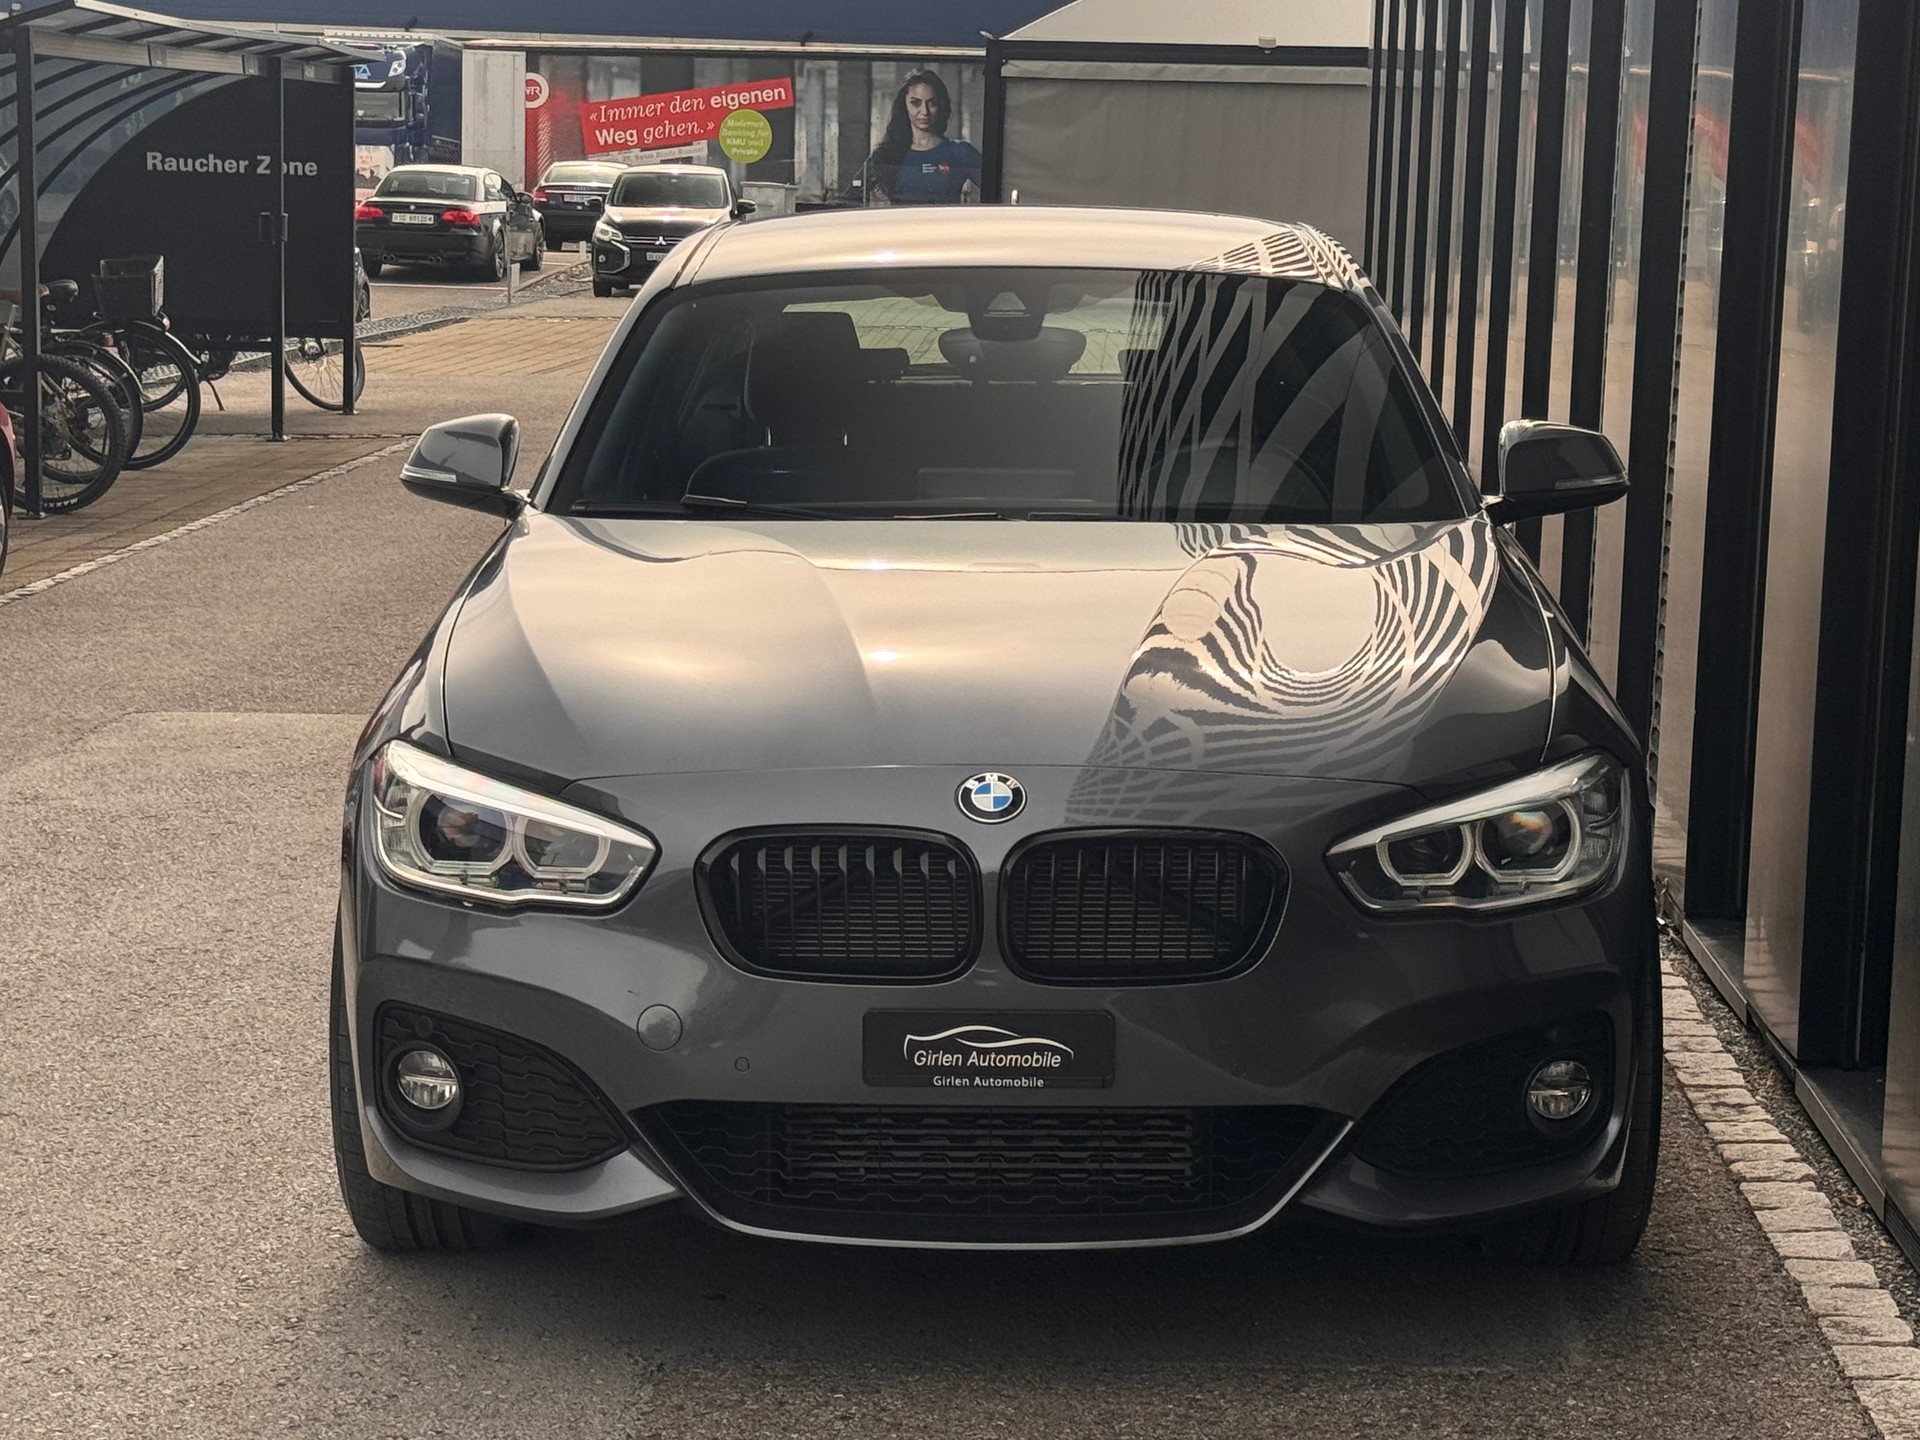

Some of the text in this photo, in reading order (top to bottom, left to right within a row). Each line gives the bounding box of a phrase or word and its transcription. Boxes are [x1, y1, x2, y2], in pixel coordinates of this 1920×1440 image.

[669, 95, 706, 114] den
[710, 87, 786, 110] eigenen
[594, 127, 638, 146] Weg
[726, 138, 746, 146] KMU
[146, 151, 249, 174] Raucher
[965, 773, 1019, 790] BMW
[913, 1050, 1062, 1068] Girlen Automobile
[932, 1075, 1045, 1088] Girlen Automobile
